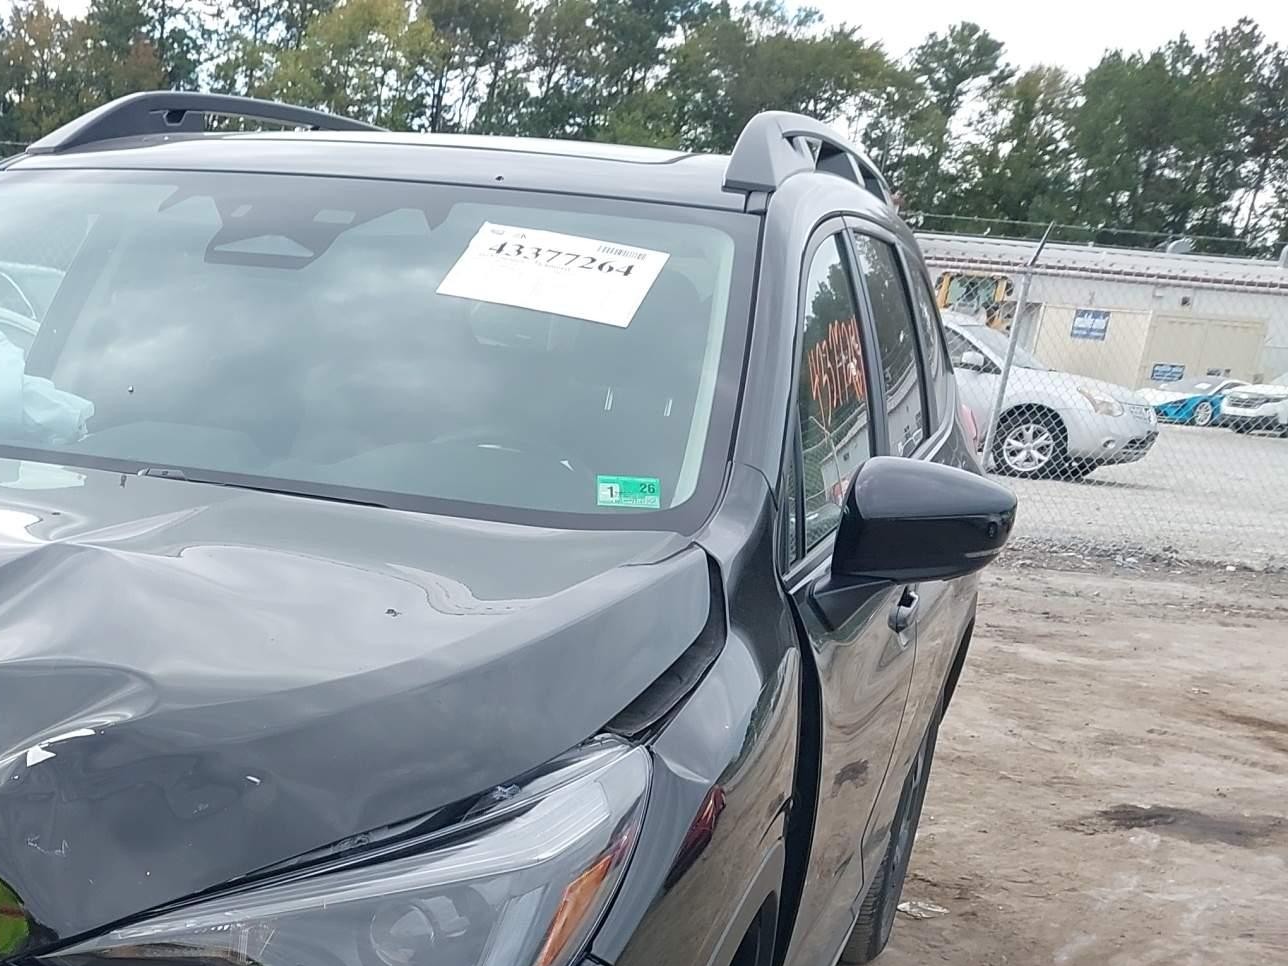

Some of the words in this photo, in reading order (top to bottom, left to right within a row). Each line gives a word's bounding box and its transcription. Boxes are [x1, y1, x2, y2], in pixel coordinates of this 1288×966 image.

[489, 241, 635, 277] 43377264
[607, 486, 614, 498] 1
[639, 483, 656, 494] 26
